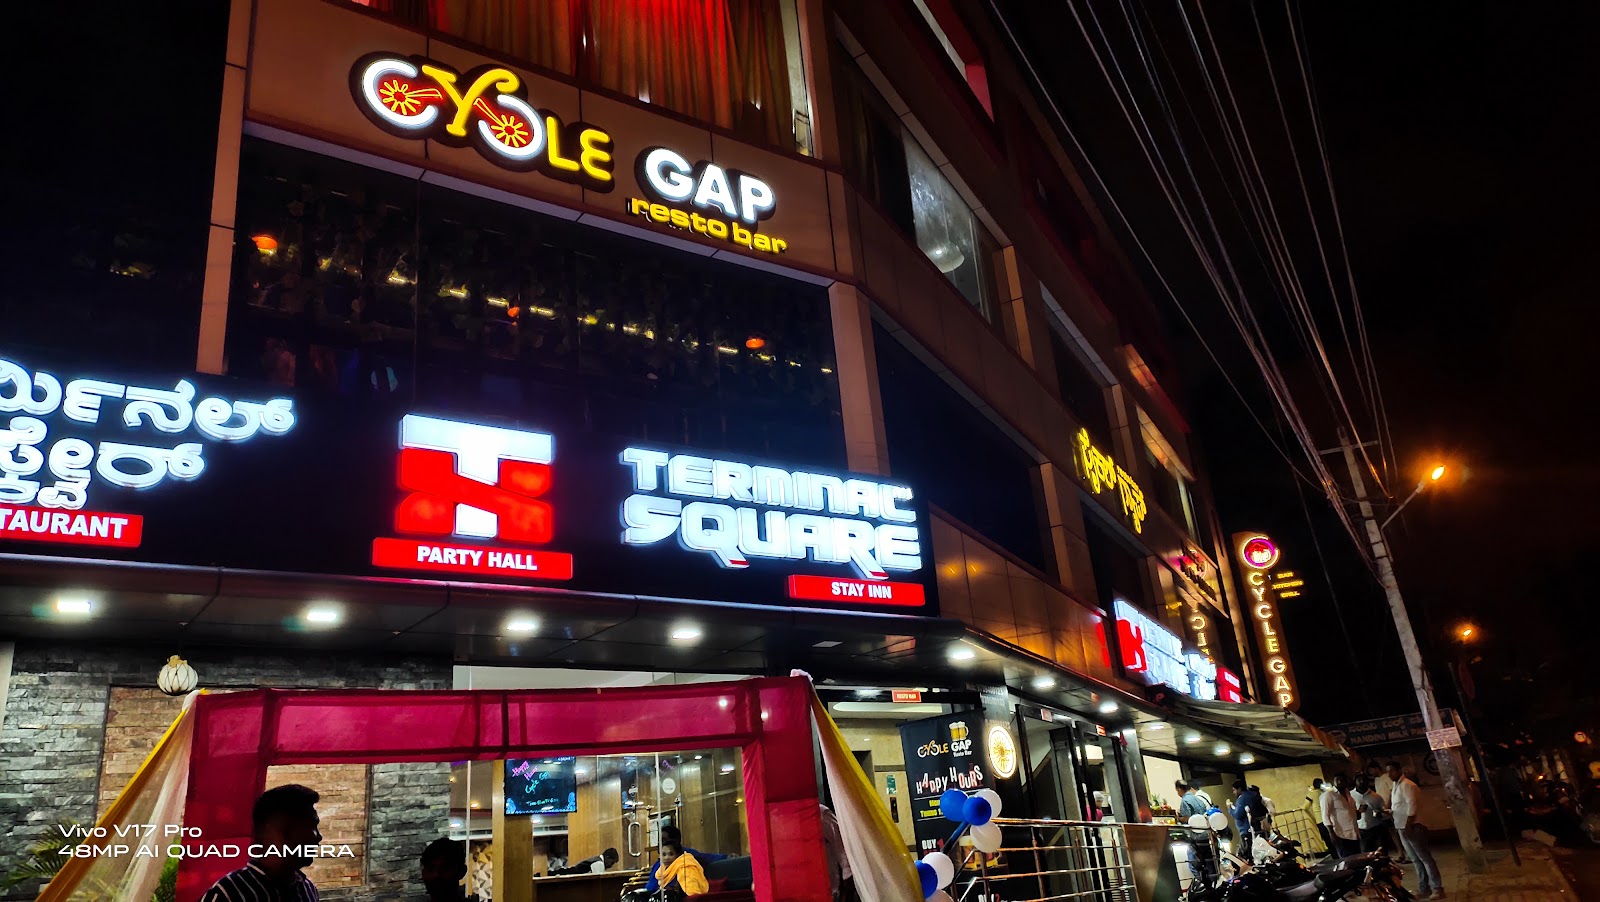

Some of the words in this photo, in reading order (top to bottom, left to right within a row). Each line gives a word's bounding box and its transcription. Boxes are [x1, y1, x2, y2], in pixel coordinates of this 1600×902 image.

[362, 58, 613, 182] CYCLE
[645, 147, 774, 221] GAP
[631, 196, 728, 239] resto
[732, 220, 788, 255] bar
[619, 447, 917, 523] TERMINAL
[417, 546, 482, 567] PARTY
[487, 550, 537, 571] HALL
[620, 494, 922, 580] SQUARE
[831, 581, 864, 598] STAY
[868, 584, 893, 600] INN
[1250, 572, 1279, 653] CYCLE
[1270, 659, 1292, 708] GAP
[951, 739, 972, 752] GAP
[922, 839, 937, 850] BUY
